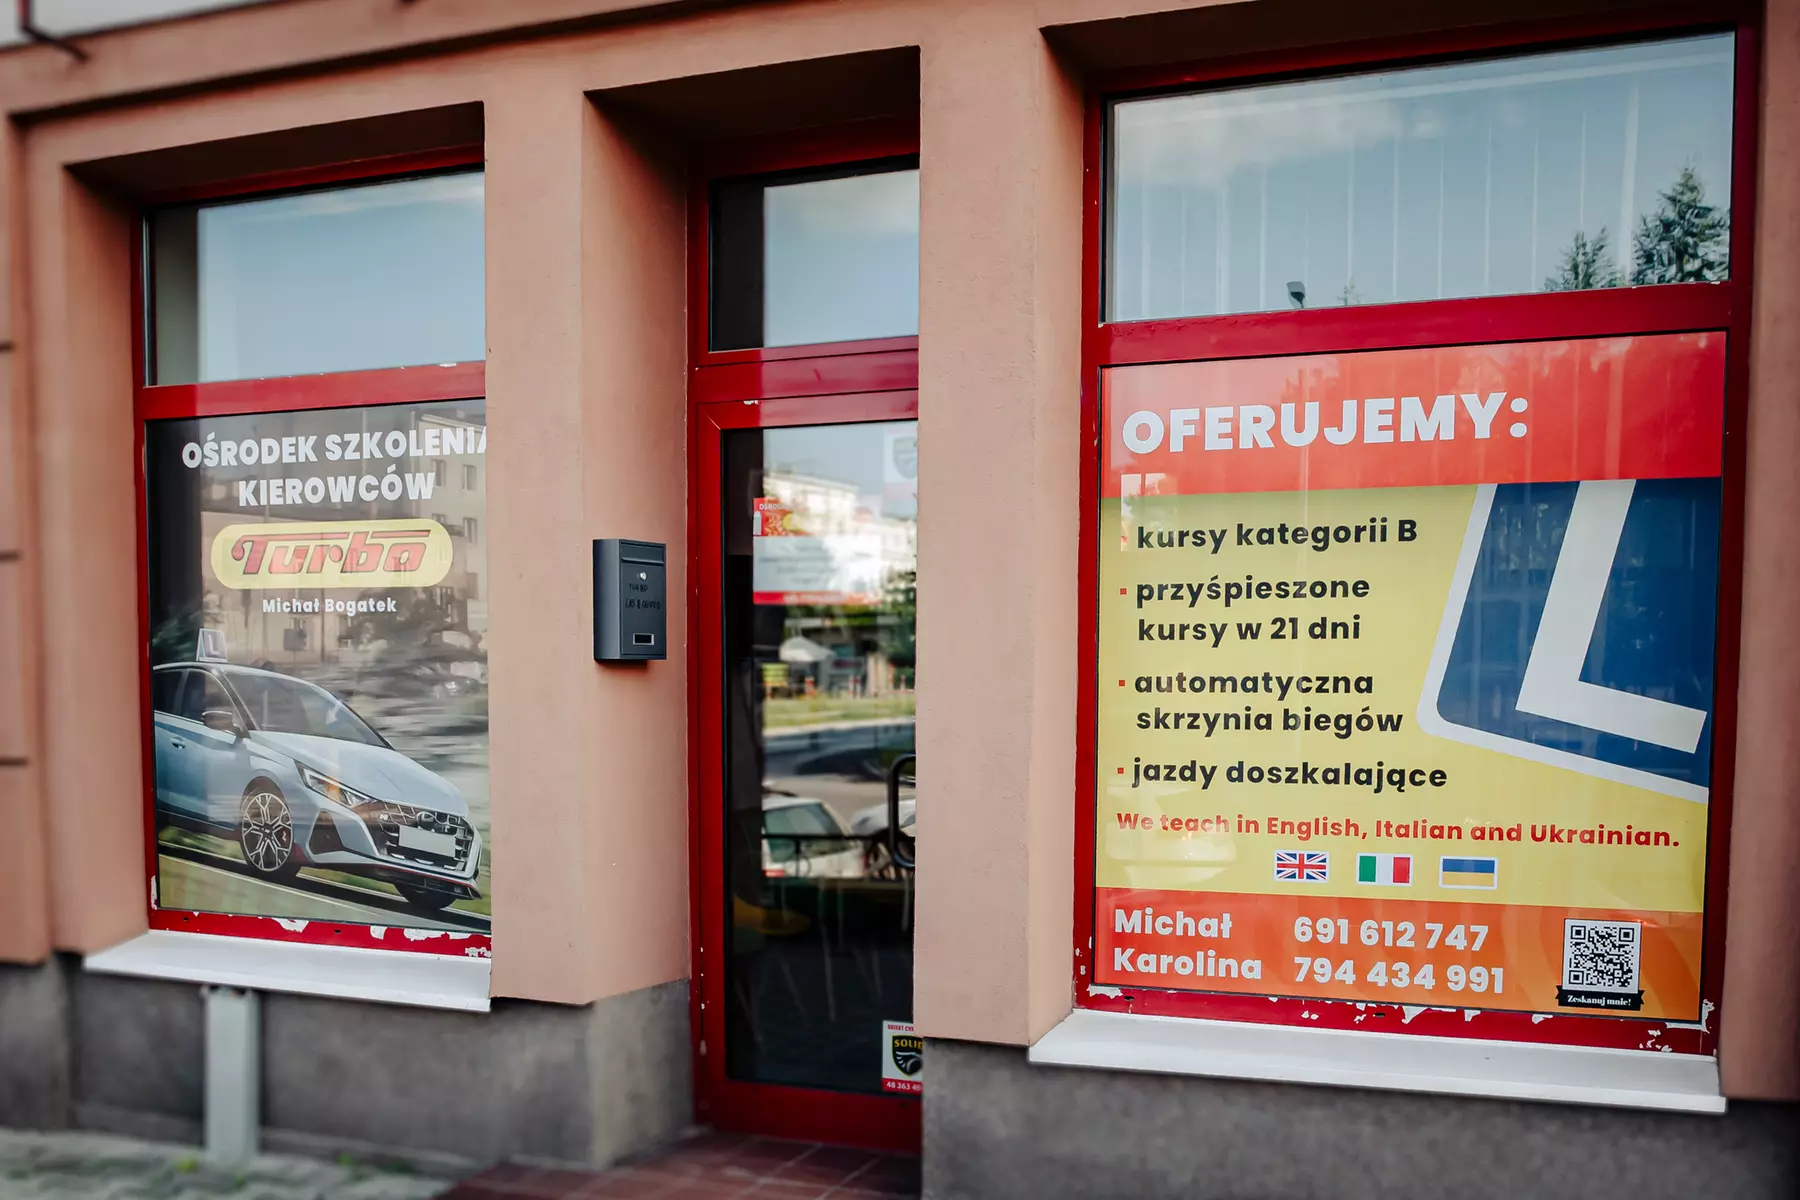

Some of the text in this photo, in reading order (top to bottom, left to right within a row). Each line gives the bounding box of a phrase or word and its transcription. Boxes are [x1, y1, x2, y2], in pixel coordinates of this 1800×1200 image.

[1122, 392, 1528, 454] OFERUJEMY:
[182, 432, 318, 468] OŚRODEK
[238, 464, 436, 506] KIEROWCÓW
[231, 529, 432, 576] Turbo
[1137, 517, 1418, 554] kursy kategorii B
[262, 597, 397, 617] Michał Bogatek
[1136, 574, 1370, 608] przyśpieszone
[1138, 614, 1361, 647] kursy w 21 dni
[1134, 672, 1373, 701] automatyczna
[1136, 706, 1403, 740] skrzynia biegów
[1131, 757, 1448, 794] jazdy doszkalające
[1117, 813, 1680, 848] We teach in English, Italian and Ukrainian.
[1114, 907, 1489, 951] Michał 691 612 747
[1113, 947, 1504, 994] Karolina 794 434 991
[1567, 995, 1632, 1007] Zeskanuj mnie!
